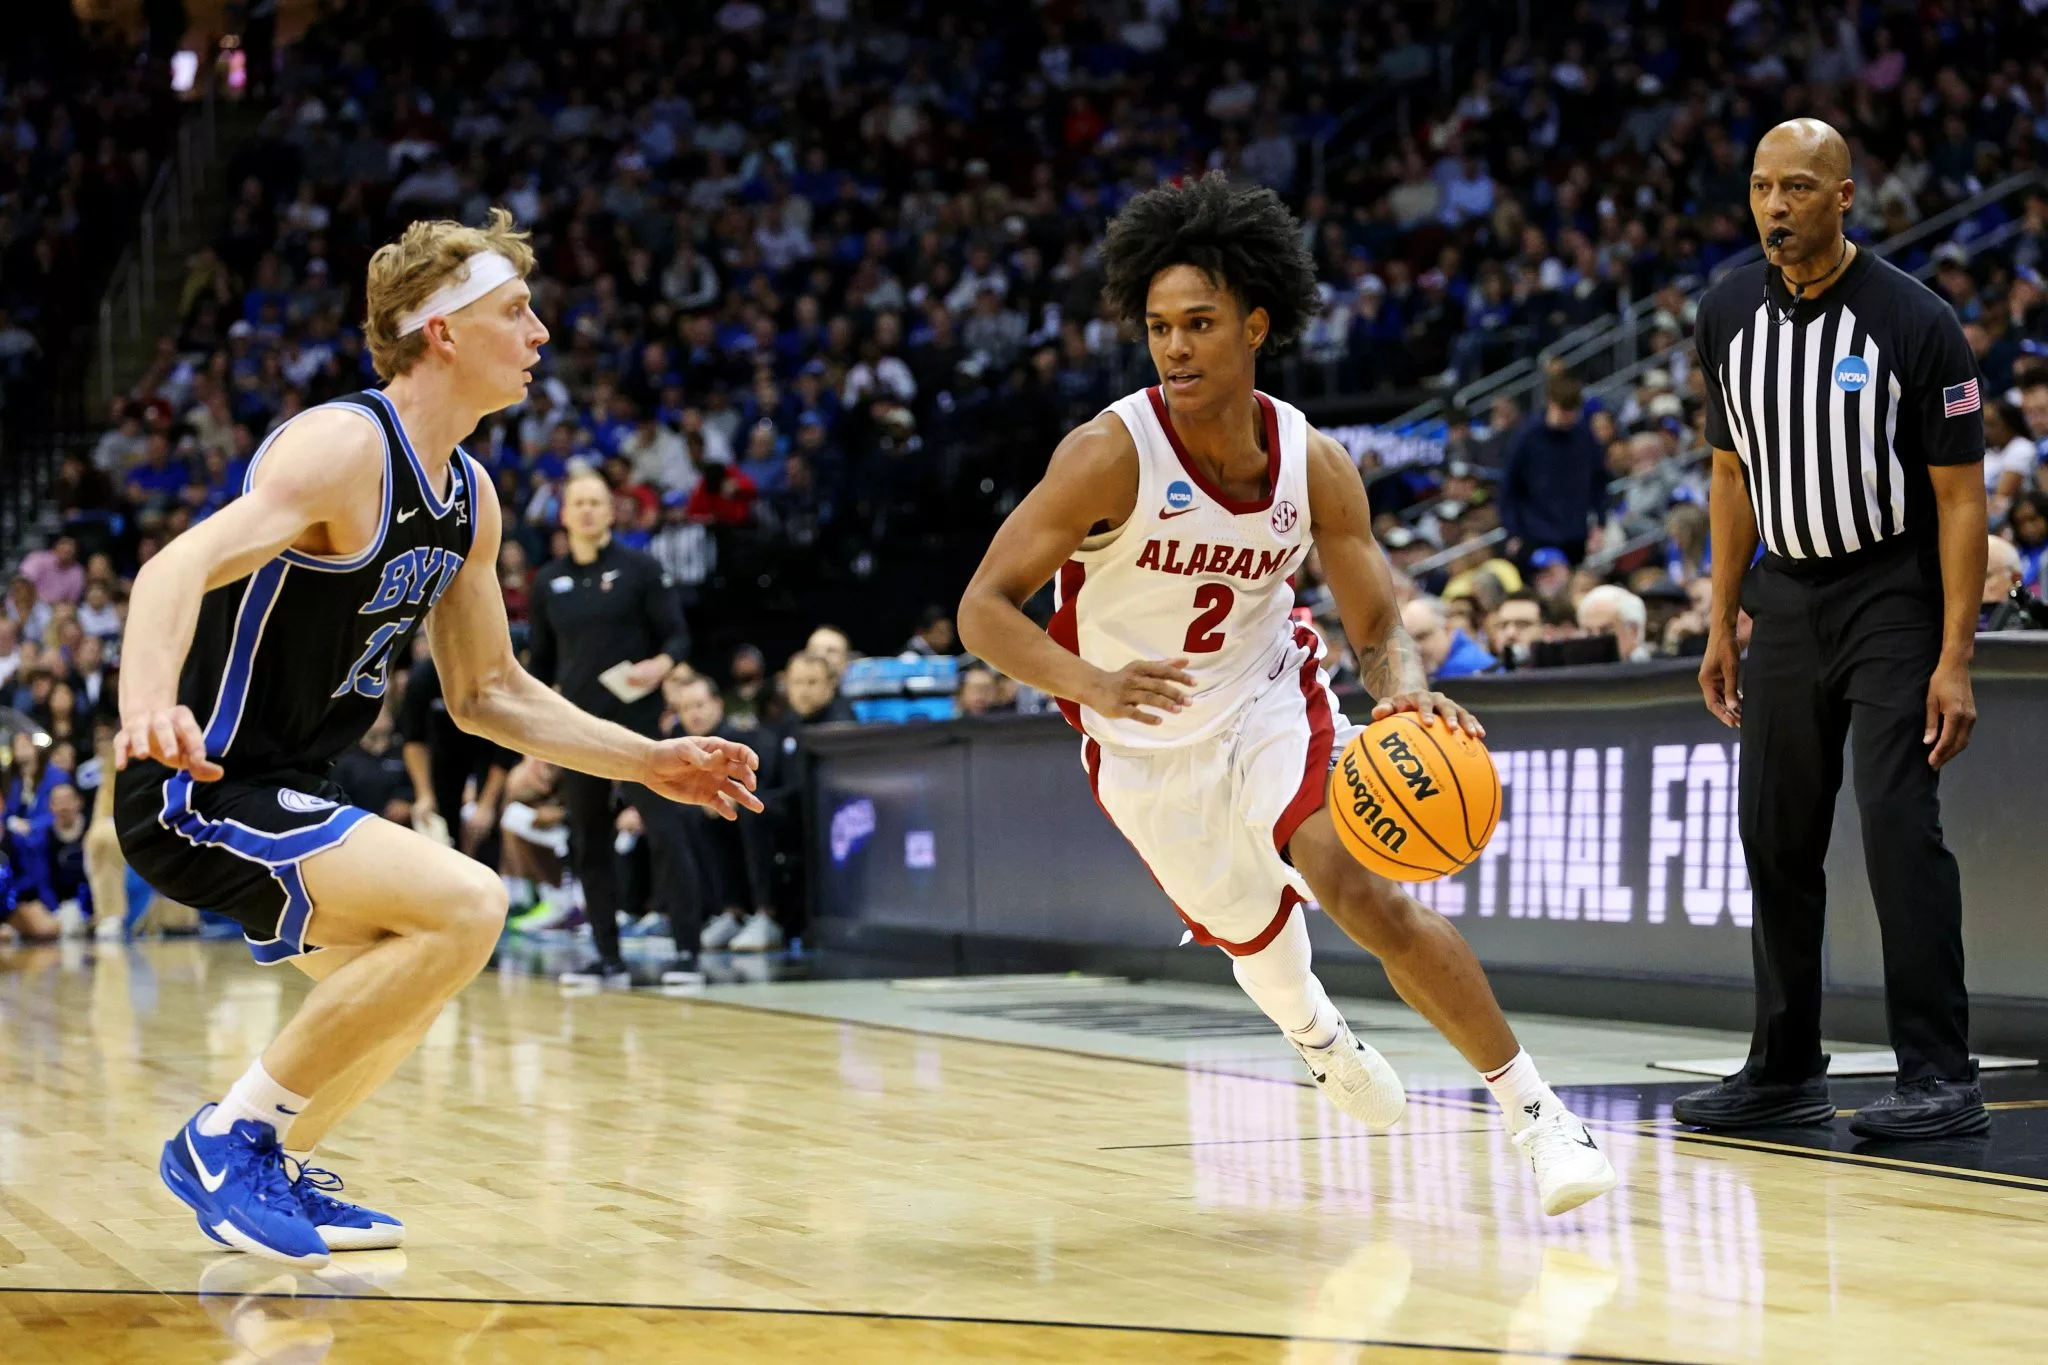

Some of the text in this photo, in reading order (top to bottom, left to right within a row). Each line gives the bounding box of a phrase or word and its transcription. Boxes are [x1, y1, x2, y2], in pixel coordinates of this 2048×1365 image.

[1838, 371, 1867, 384] NCAA
[1272, 501, 1297, 533] SEC
[1136, 539, 1301, 580] ALABAM
[1183, 582, 1235, 654] 2
[1343, 748, 1408, 854] Wilson
[1379, 731, 1440, 802] NCAA
[1478, 747, 1633, 923] FINAL
